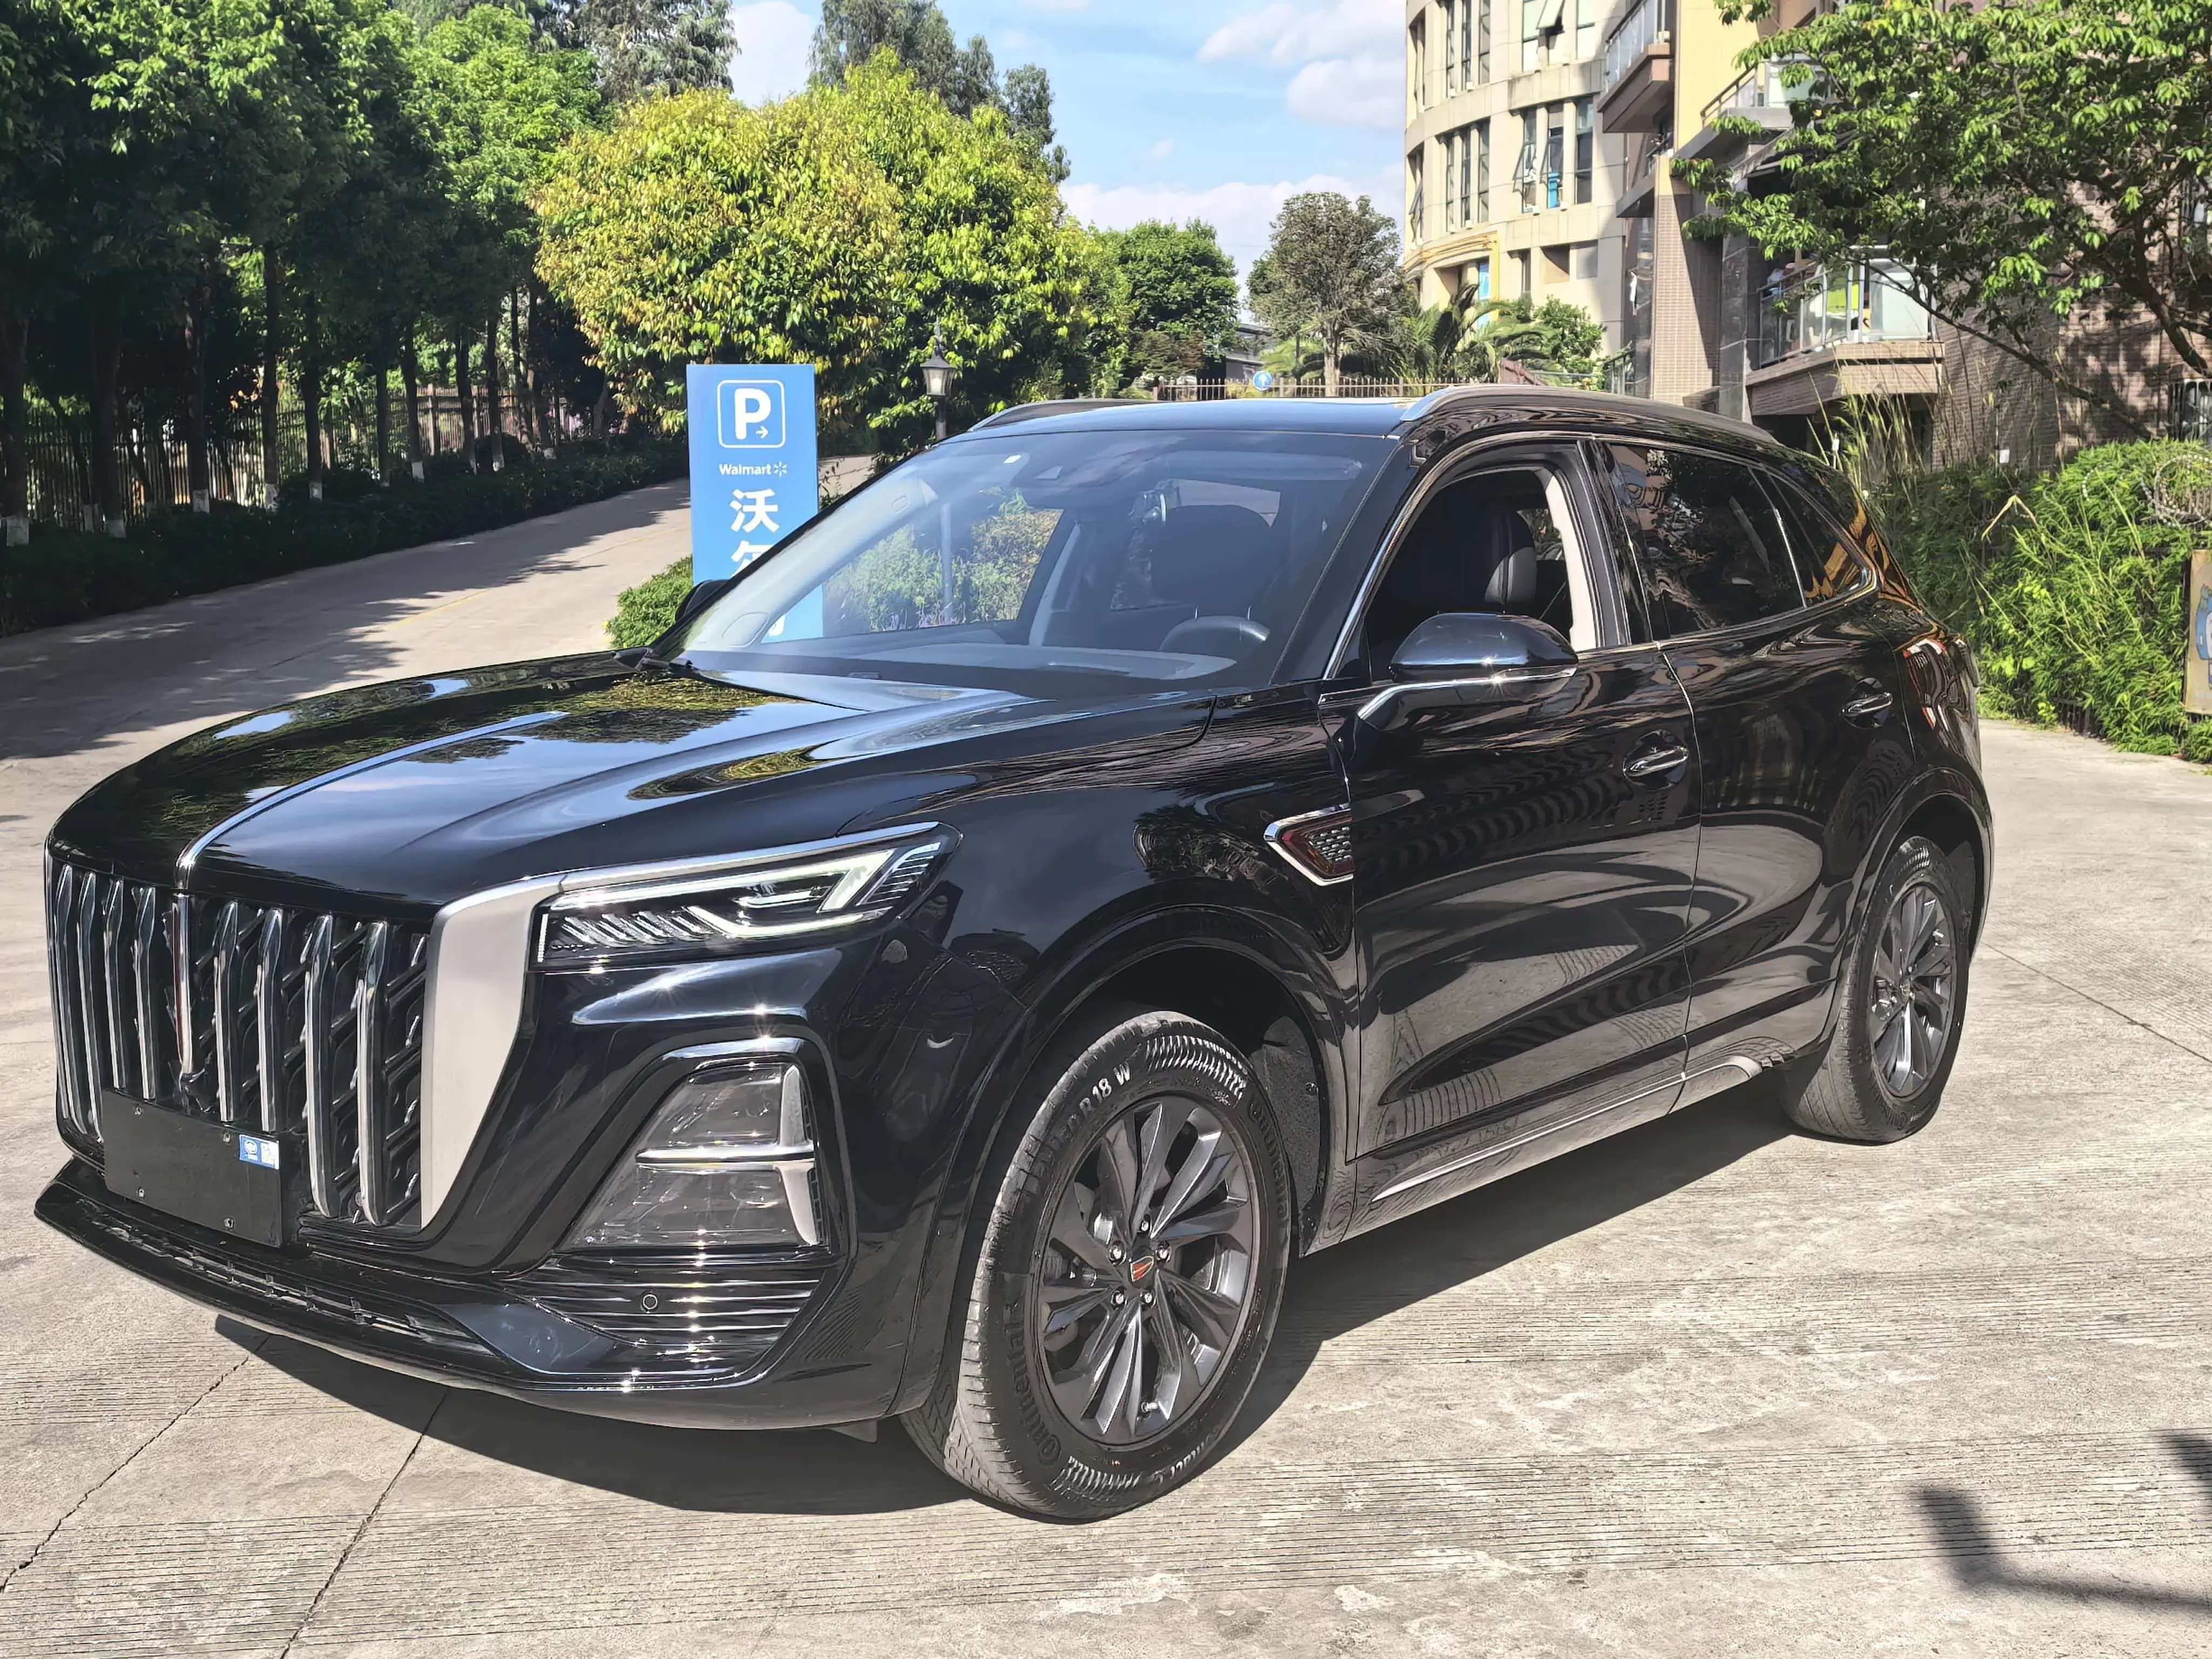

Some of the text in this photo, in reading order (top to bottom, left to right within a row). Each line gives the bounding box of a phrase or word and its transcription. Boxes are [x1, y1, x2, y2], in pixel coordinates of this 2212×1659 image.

[734, 388, 772, 440] P
[719, 463, 772, 475] Walmart
[1092, 1078, 1112, 1104] 18
[1114, 1061, 1131, 1086] W
